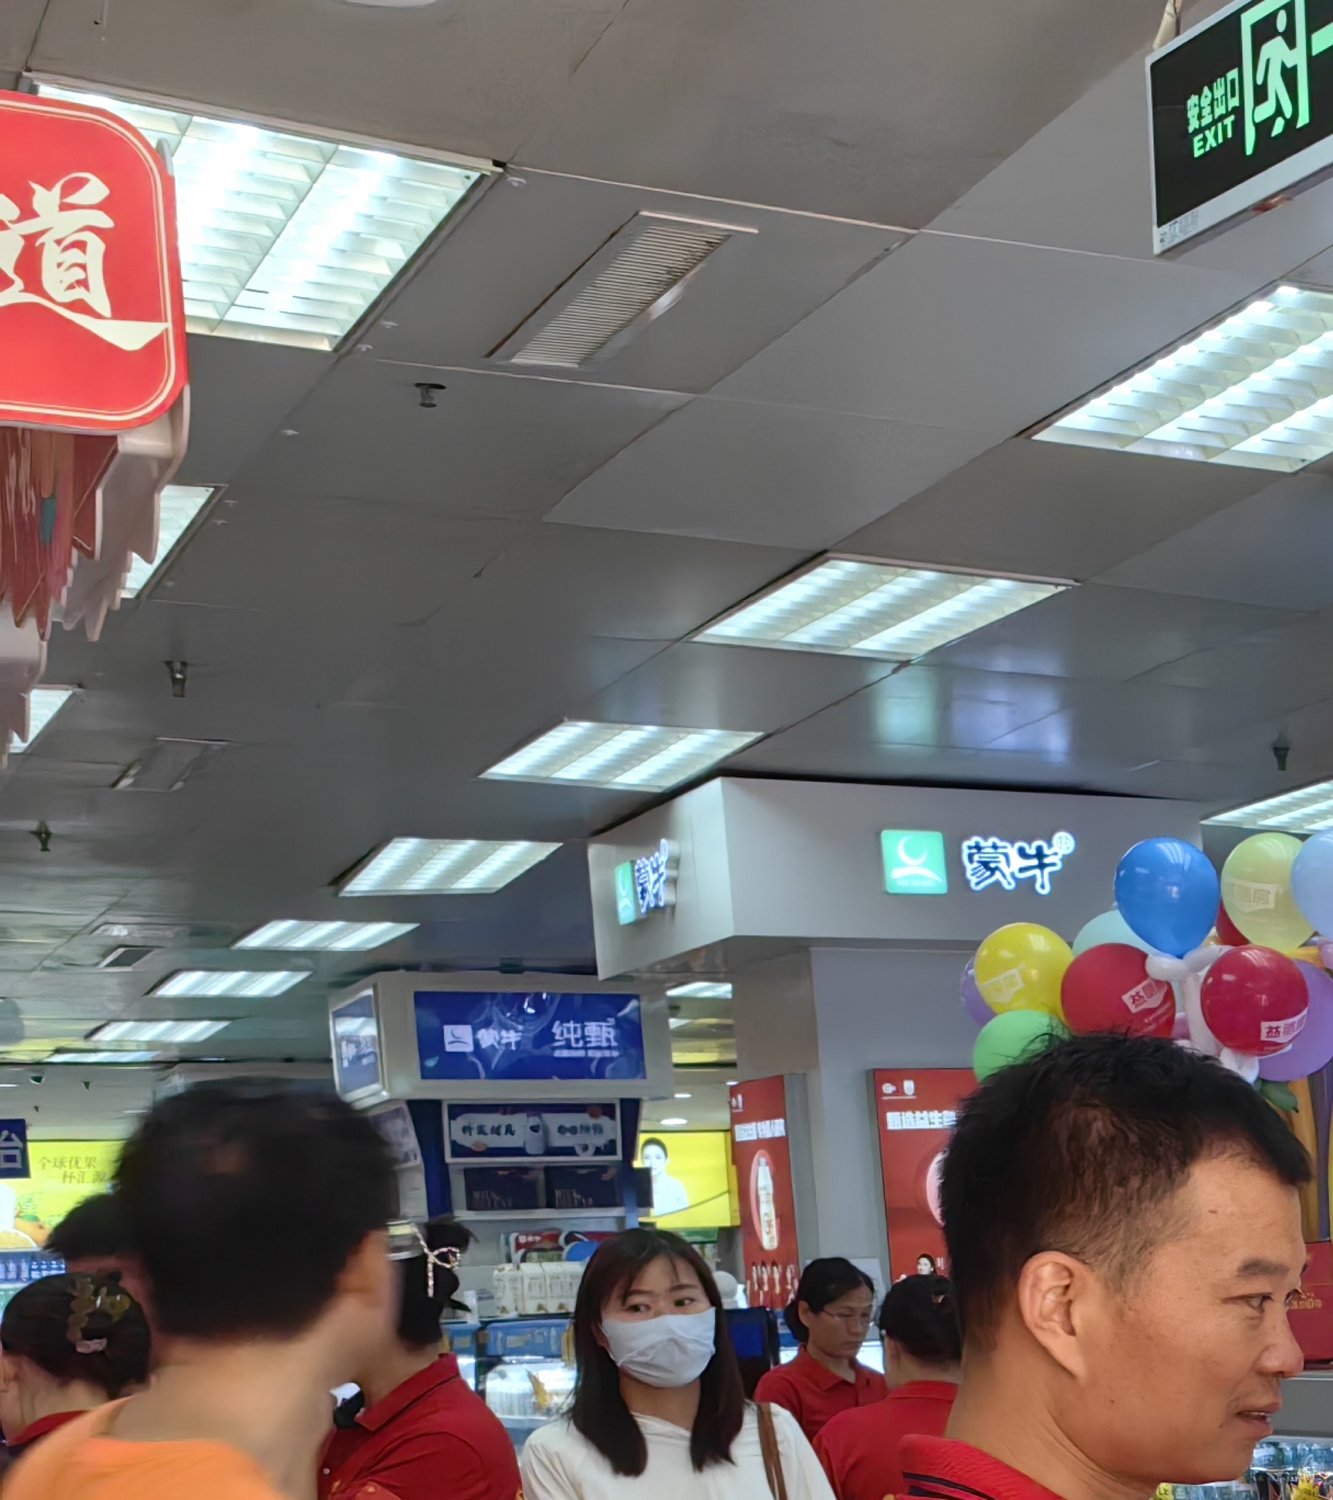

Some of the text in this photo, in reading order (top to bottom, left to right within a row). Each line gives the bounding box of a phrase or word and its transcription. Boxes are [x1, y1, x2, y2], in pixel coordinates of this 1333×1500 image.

[1187, 68, 1240, 133] 安全出口
[1193, 115, 1236, 158] EXIT
[962, 837, 1063, 894] 蒙牛
[551, 1018, 618, 1048] 纯甄
